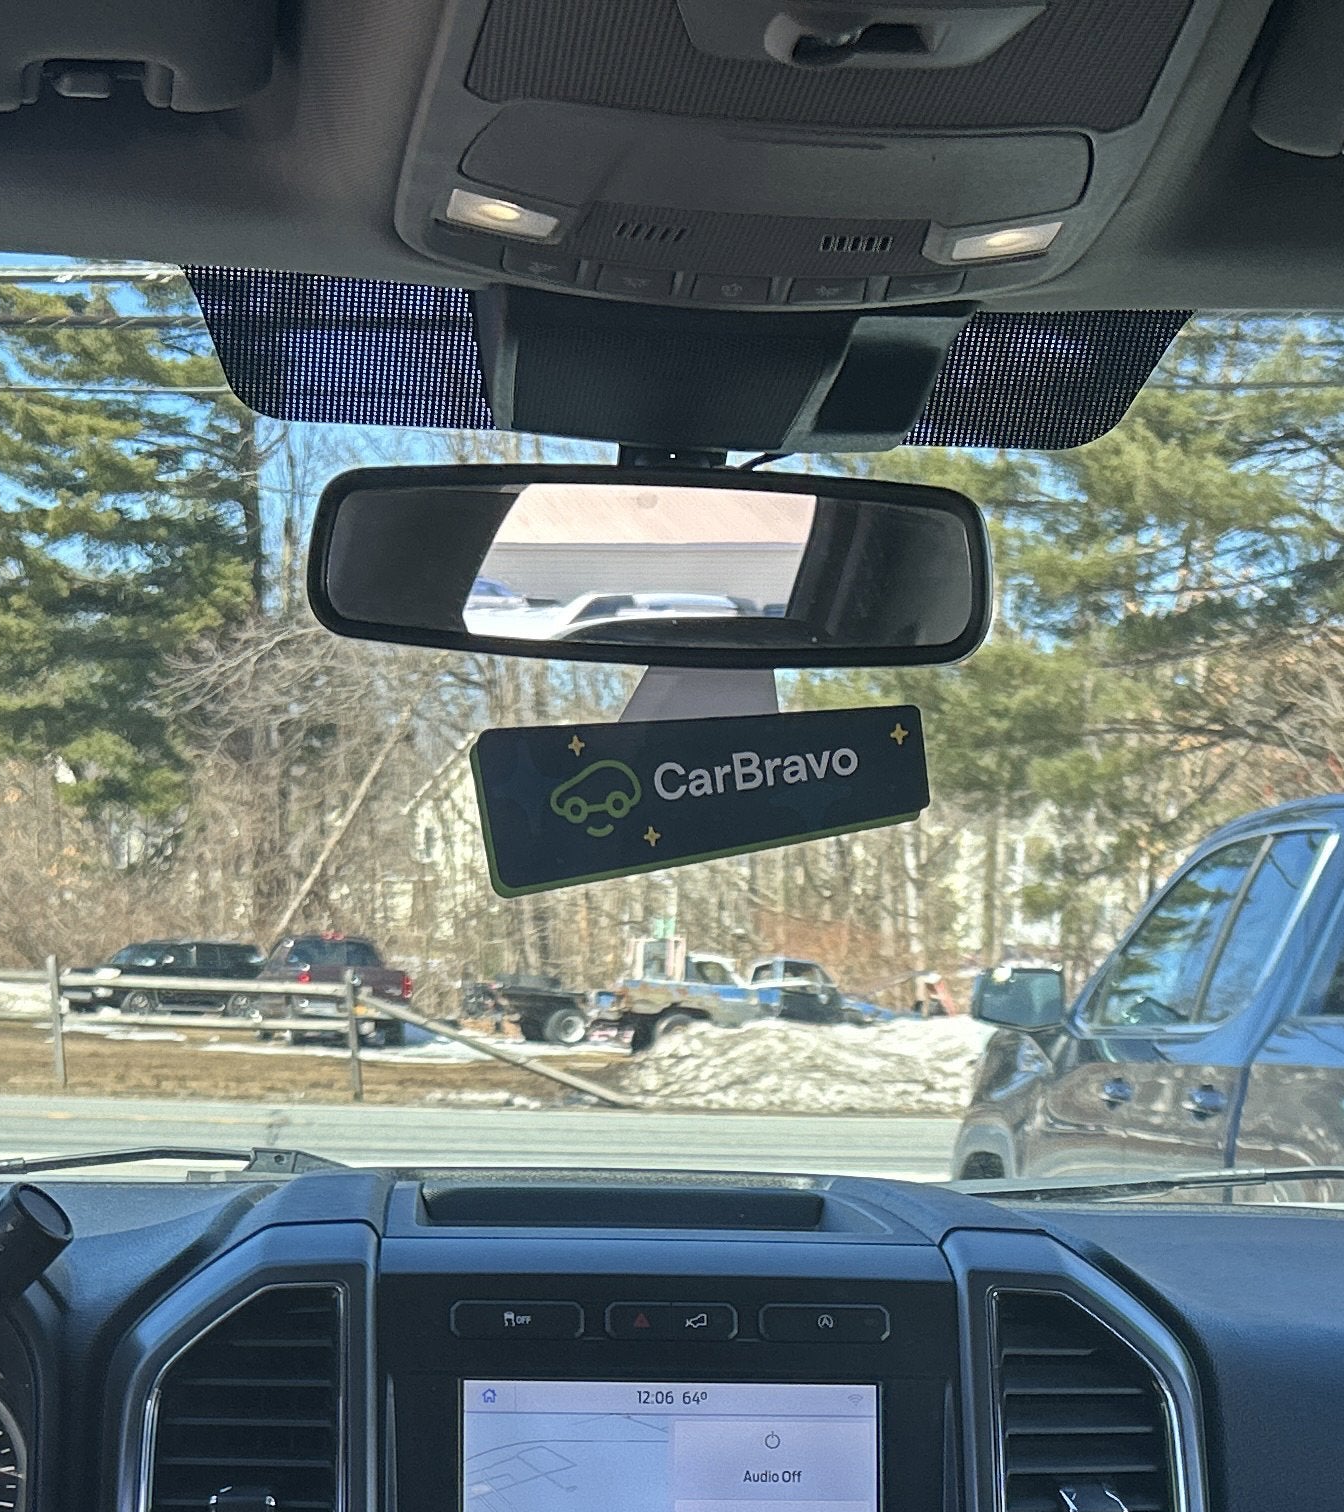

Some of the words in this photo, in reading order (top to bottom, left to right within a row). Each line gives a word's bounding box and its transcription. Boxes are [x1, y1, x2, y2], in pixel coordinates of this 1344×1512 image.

[654, 748, 858, 800] CarBravo
[516, 1315, 532, 1325] OFF
[636, 1390, 674, 1405] 12:06
[743, 1470, 779, 1483] Audio
[782, 1470, 802, 1483] Off
